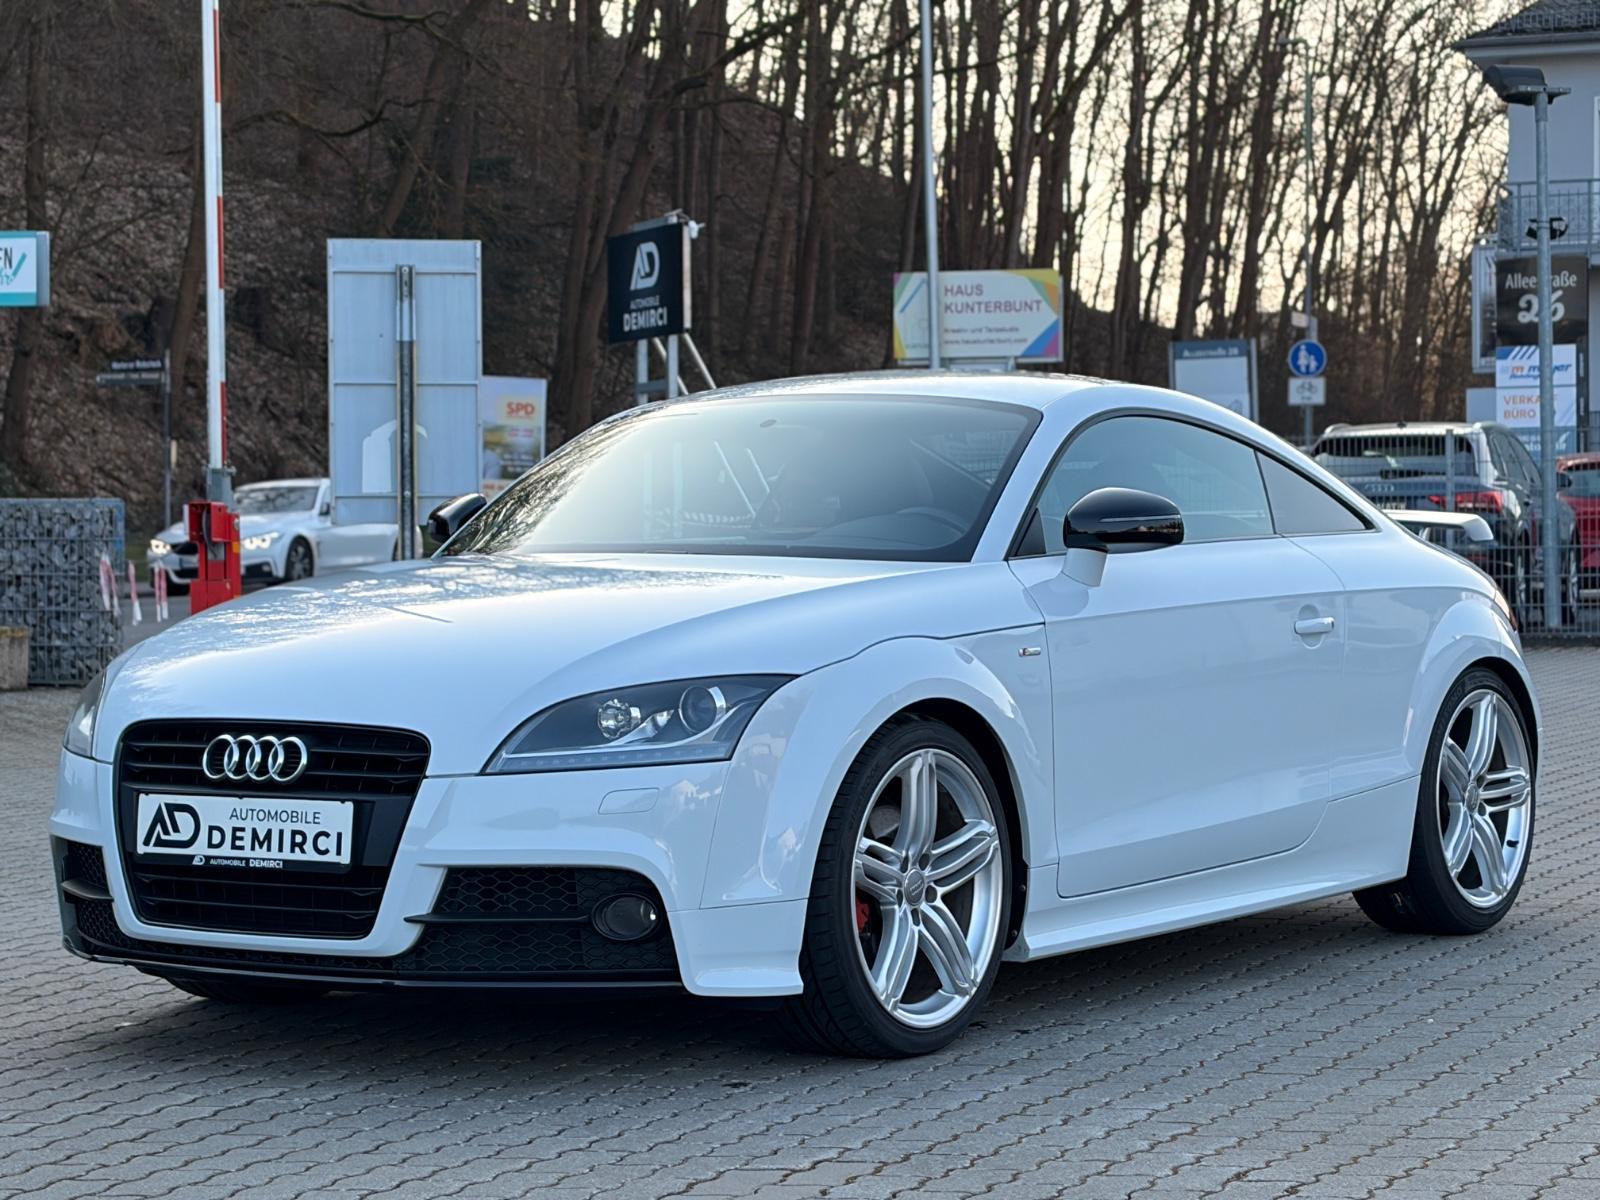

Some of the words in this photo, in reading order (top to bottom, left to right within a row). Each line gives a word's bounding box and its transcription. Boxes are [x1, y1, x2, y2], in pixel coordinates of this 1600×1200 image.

[1504, 270, 1578, 290] Alleeaße
[943, 284, 984, 297] HAUS
[943, 300, 1043, 314] KUNTERBUNT
[623, 306, 668, 332] DEMIRCI
[505, 401, 536, 416] SPD
[1503, 408, 1537, 420] BÜRO
[229, 807, 321, 825] AUTOMOBILE
[206, 824, 343, 857] DEMIRCI
[210, 858, 246, 867] AUTOMOBILE
[249, 859, 283, 869] DEMIRCI
